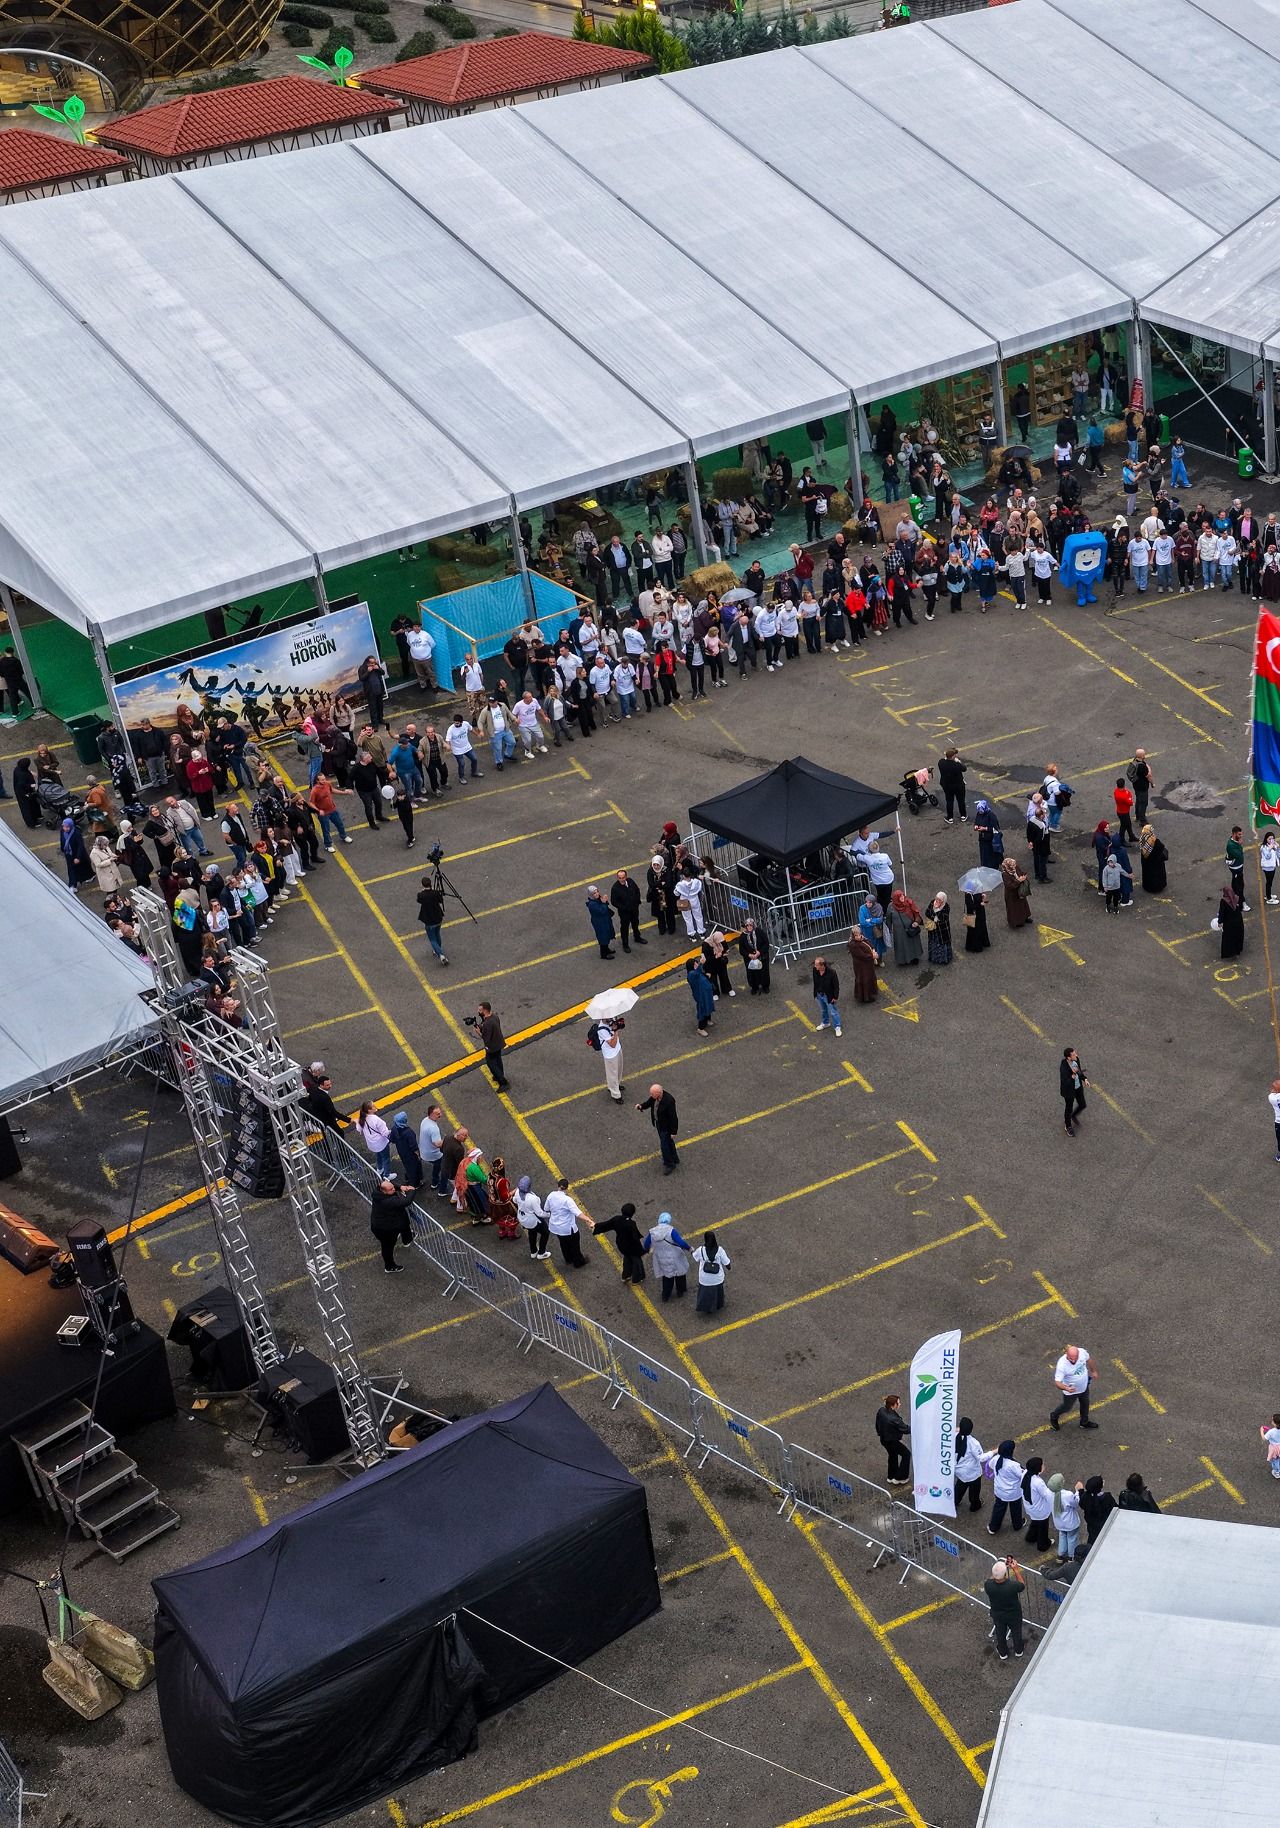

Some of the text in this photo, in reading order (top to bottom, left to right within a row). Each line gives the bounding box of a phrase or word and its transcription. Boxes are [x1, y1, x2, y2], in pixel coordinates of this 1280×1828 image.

[289, 638, 338, 667] HORON
[293, 637, 312, 650] İKLİM
[312, 632, 328, 644] İÇİN
[940, 1348, 955, 1476] GASTRONOMİ RİZE
